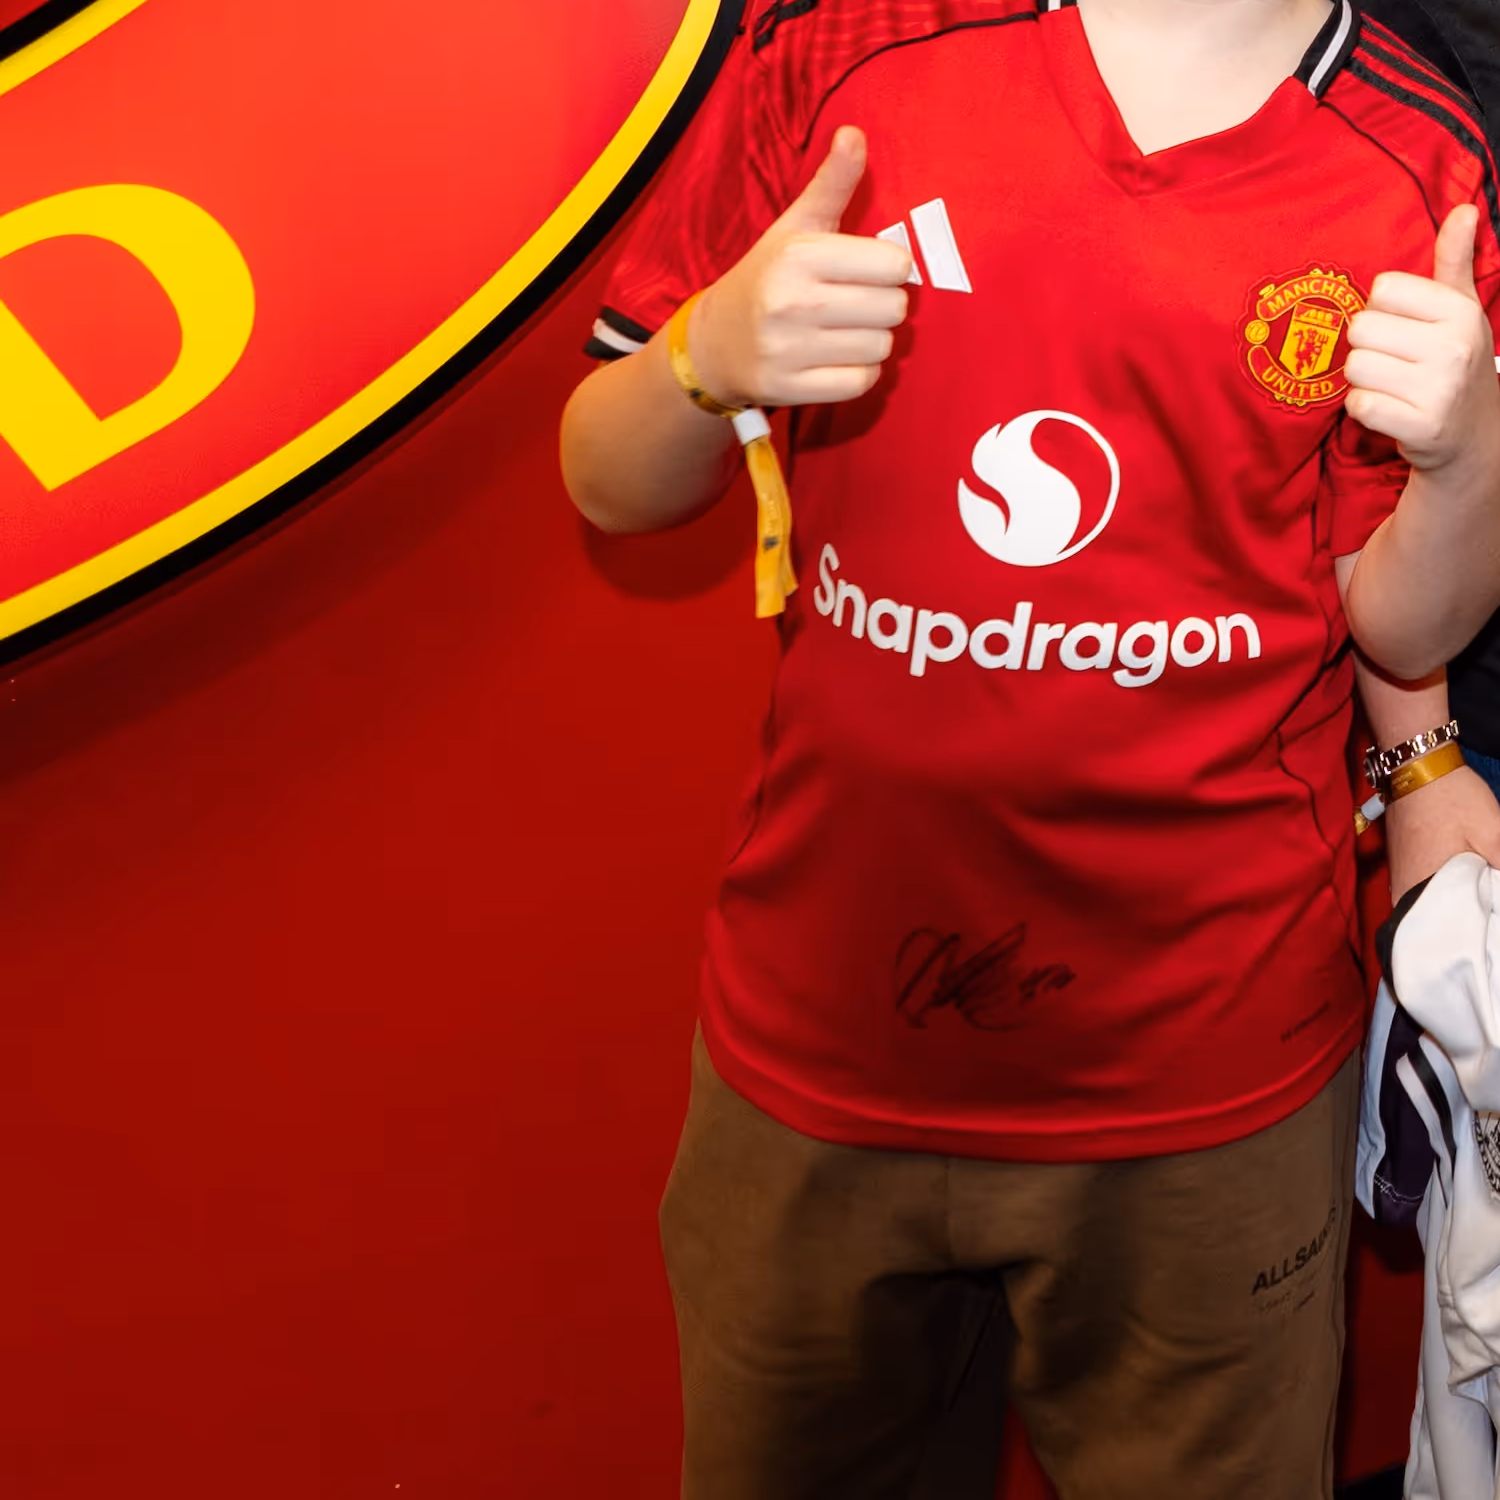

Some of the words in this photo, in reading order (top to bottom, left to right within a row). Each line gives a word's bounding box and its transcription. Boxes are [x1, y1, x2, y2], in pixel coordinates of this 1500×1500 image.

[1267, 280, 1361, 314] MANCHEST
[1262, 366, 1333, 397] UNITED
[814, 544, 1261, 688] Snapdragon
